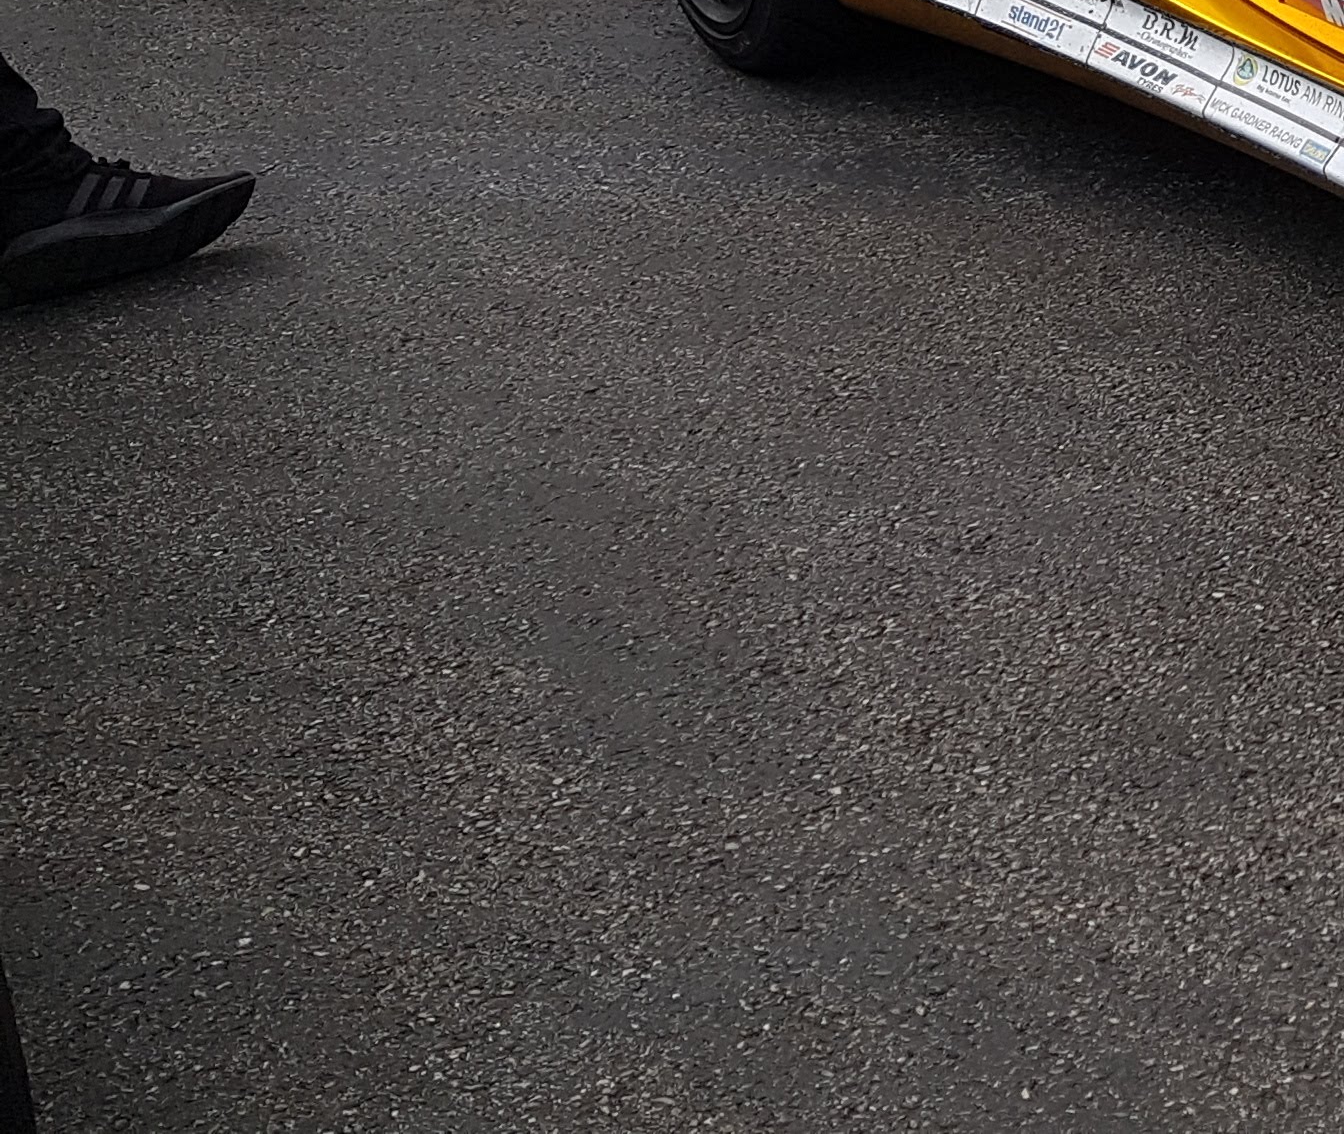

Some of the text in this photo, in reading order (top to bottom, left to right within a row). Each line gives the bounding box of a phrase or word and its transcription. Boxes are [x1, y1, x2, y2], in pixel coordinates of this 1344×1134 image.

[1111, 50, 1178, 86] AVON
[1137, 77, 1164, 94] TYRES
[1262, 65, 1301, 96] LOTUS
[1300, 85, 1322, 106] AM
[1270, 126, 1303, 148] RACING
